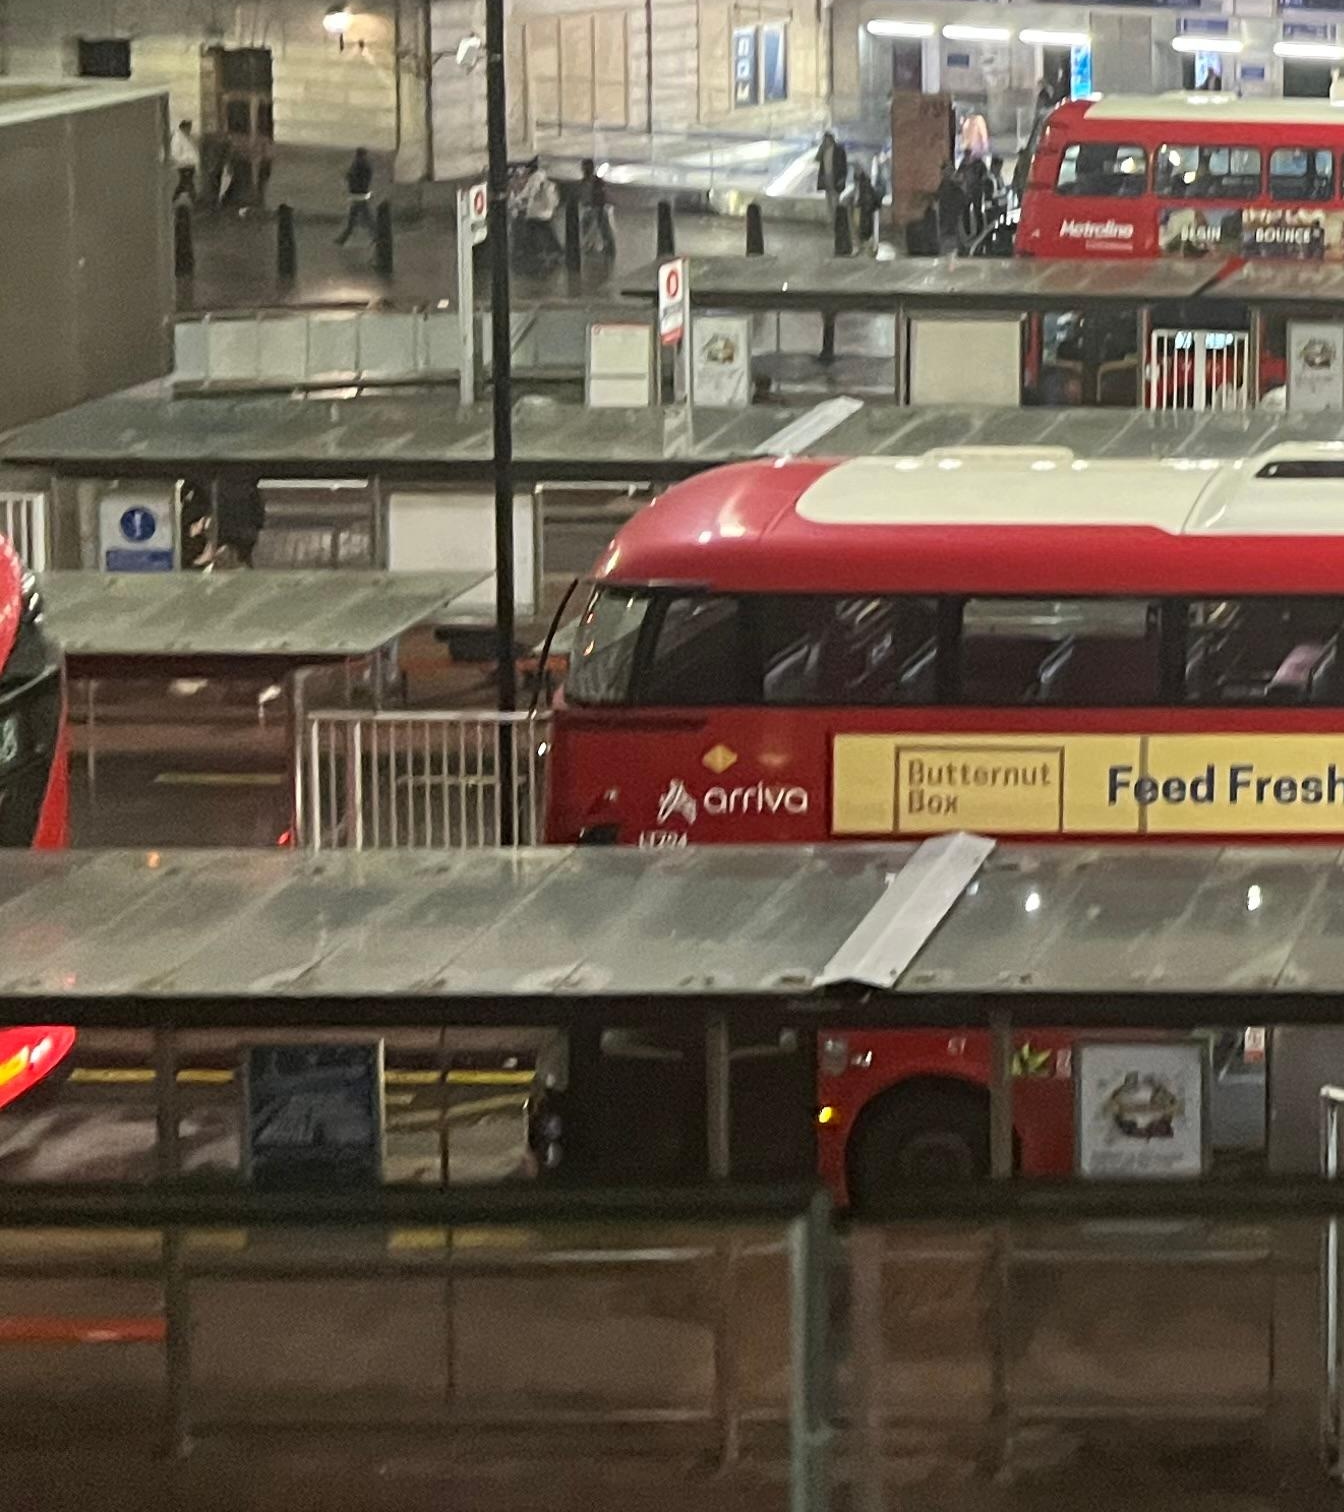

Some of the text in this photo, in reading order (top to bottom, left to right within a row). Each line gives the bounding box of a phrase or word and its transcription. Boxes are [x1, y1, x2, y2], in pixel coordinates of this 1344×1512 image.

[1060, 220, 1134, 239] Metroline
[1255, 228, 1312, 244] BOUNCE
[907, 758, 1051, 788] Butternut
[1108, 763, 1215, 806] Feed
[702, 781, 808, 816] arriva
[907, 790, 960, 816] Box
